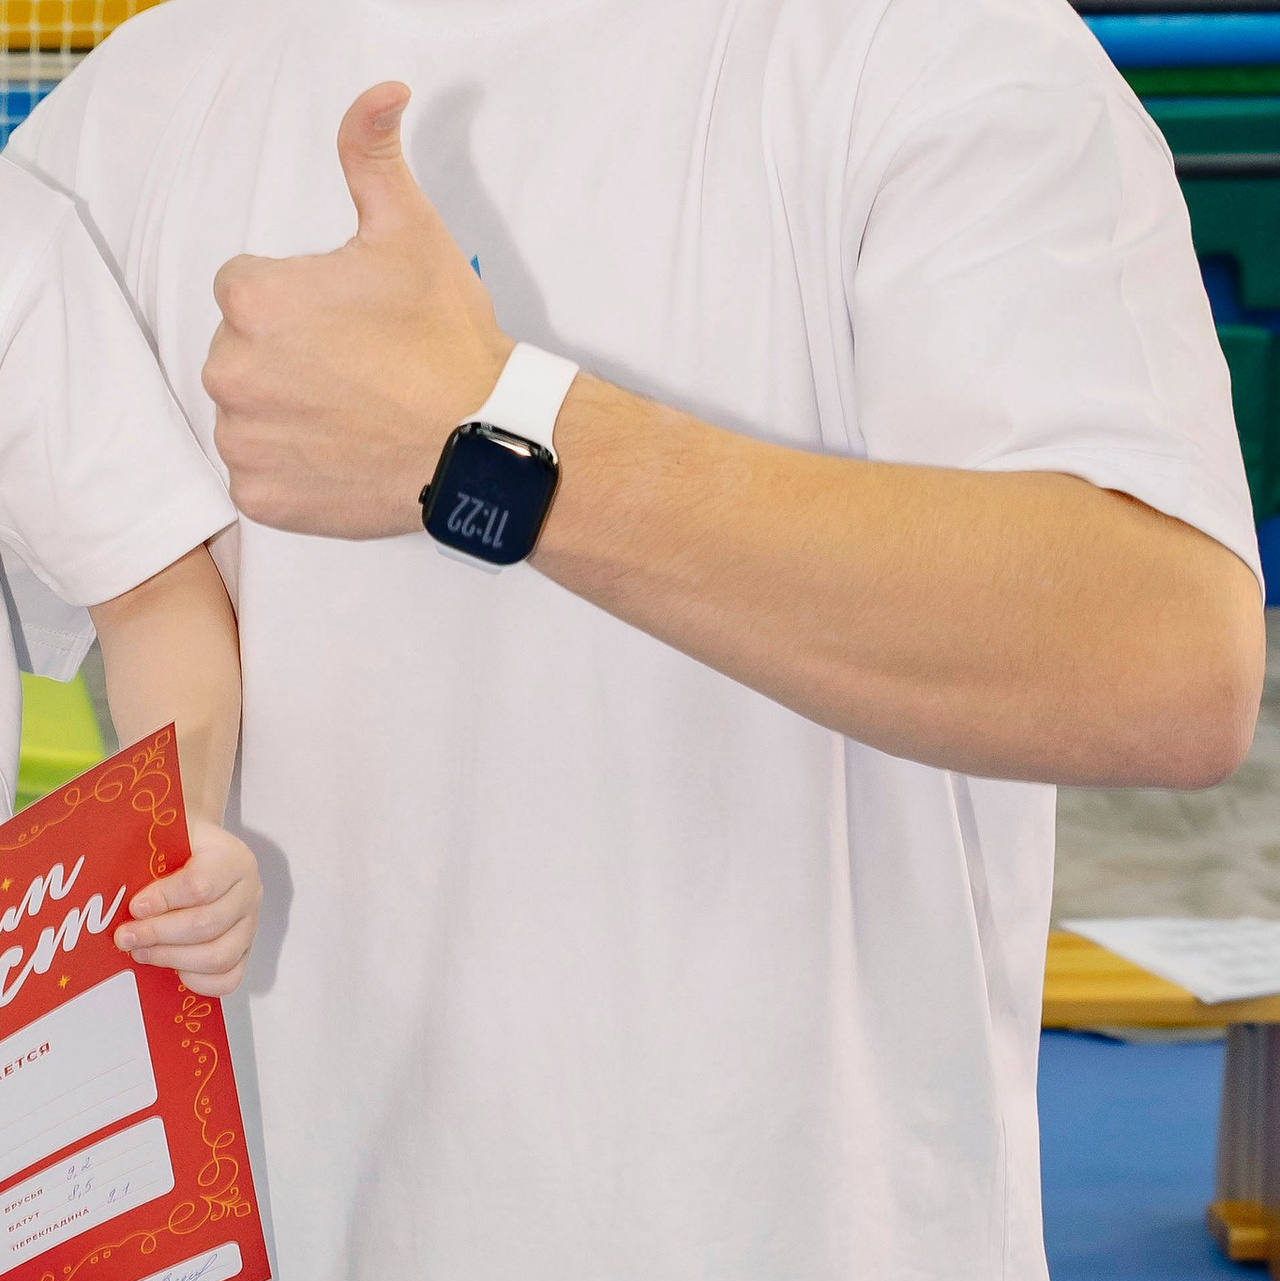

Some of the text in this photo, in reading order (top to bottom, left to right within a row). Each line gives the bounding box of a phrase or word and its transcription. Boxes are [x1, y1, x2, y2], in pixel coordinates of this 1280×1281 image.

[446, 491, 510, 549] 11:22
[4, 1188, 44, 1214] БРУСЬЯ
[8, 1211, 40, 1233] БАТУТ
[12, 1207, 90, 1252] ПЕРЕКЛАДИНА
